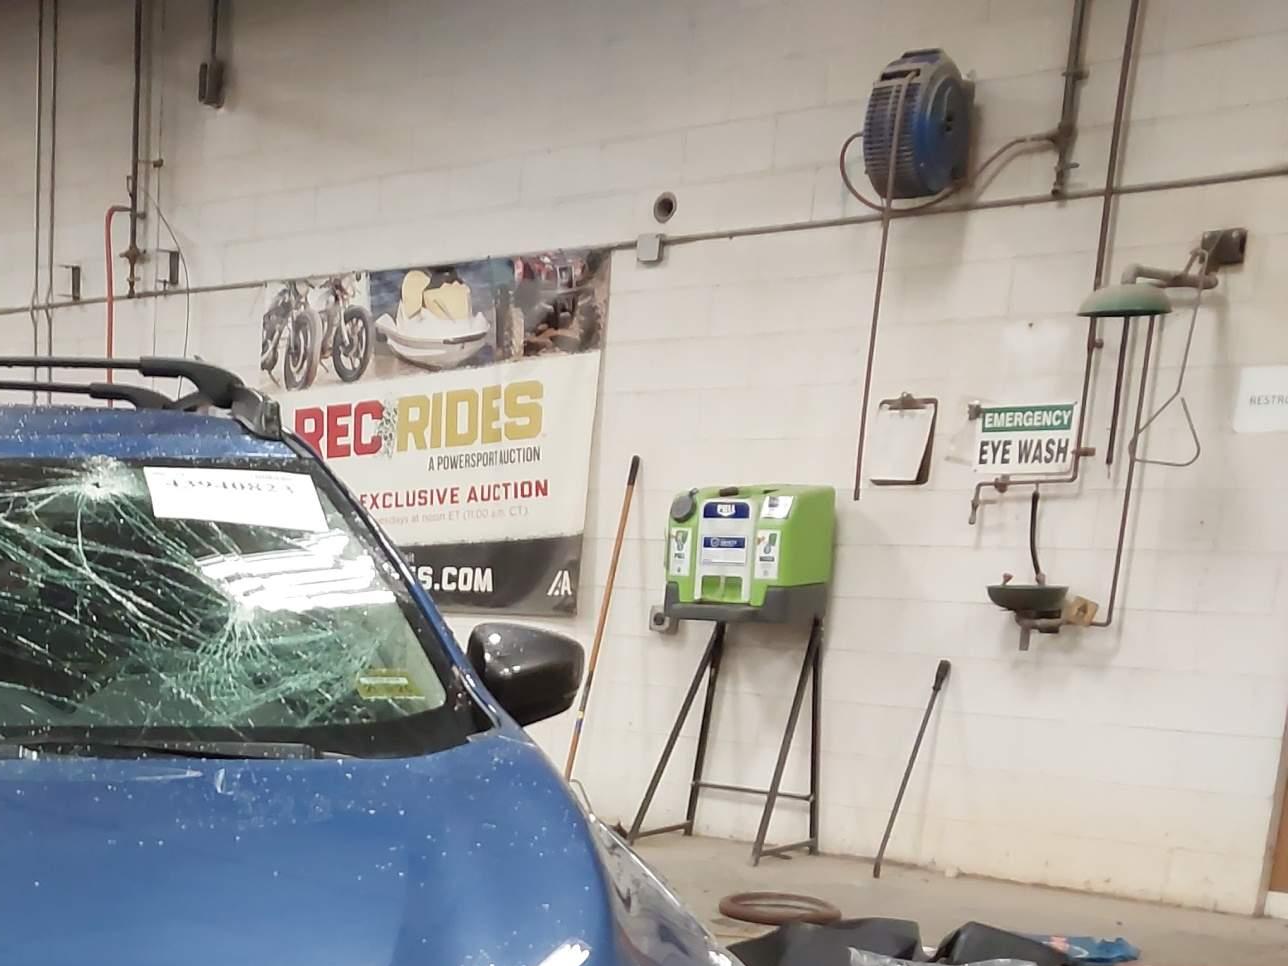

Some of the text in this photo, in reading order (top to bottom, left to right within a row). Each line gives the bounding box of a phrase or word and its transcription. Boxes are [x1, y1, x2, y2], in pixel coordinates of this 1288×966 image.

[295, 380, 544, 460] REC RIDES
[984, 410, 1072, 428] EMERGENCY
[428, 446, 541, 472] A POWERSPORT AUCTION
[979, 438, 1070, 465] EYE WASH
[360, 479, 549, 510] EXCLUSIVE AUCTION
